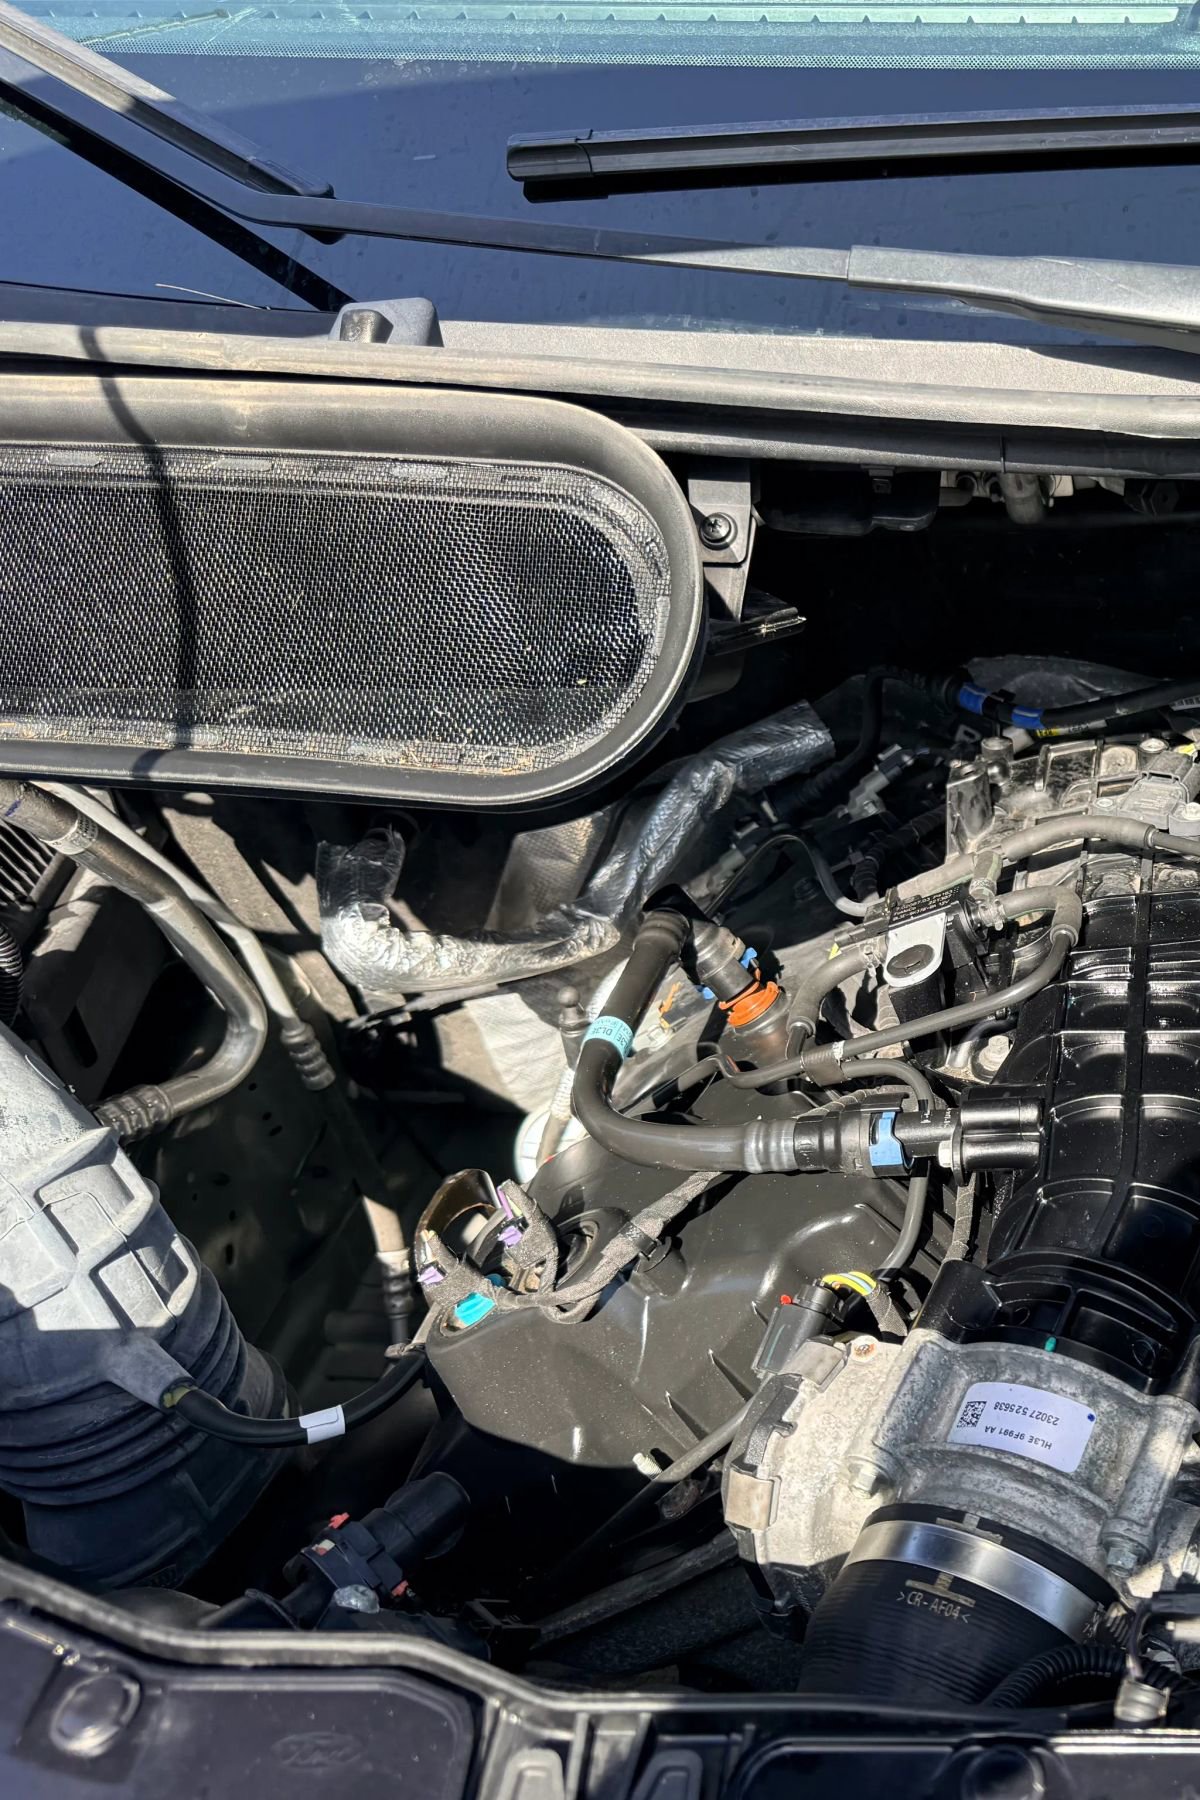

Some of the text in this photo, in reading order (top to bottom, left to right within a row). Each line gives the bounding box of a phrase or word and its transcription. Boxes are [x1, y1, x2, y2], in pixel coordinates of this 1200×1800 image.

[993, 1401, 1060, 1426] 23027 525638
[984, 1425, 1052, 1450] HL3E 9F991 AA
